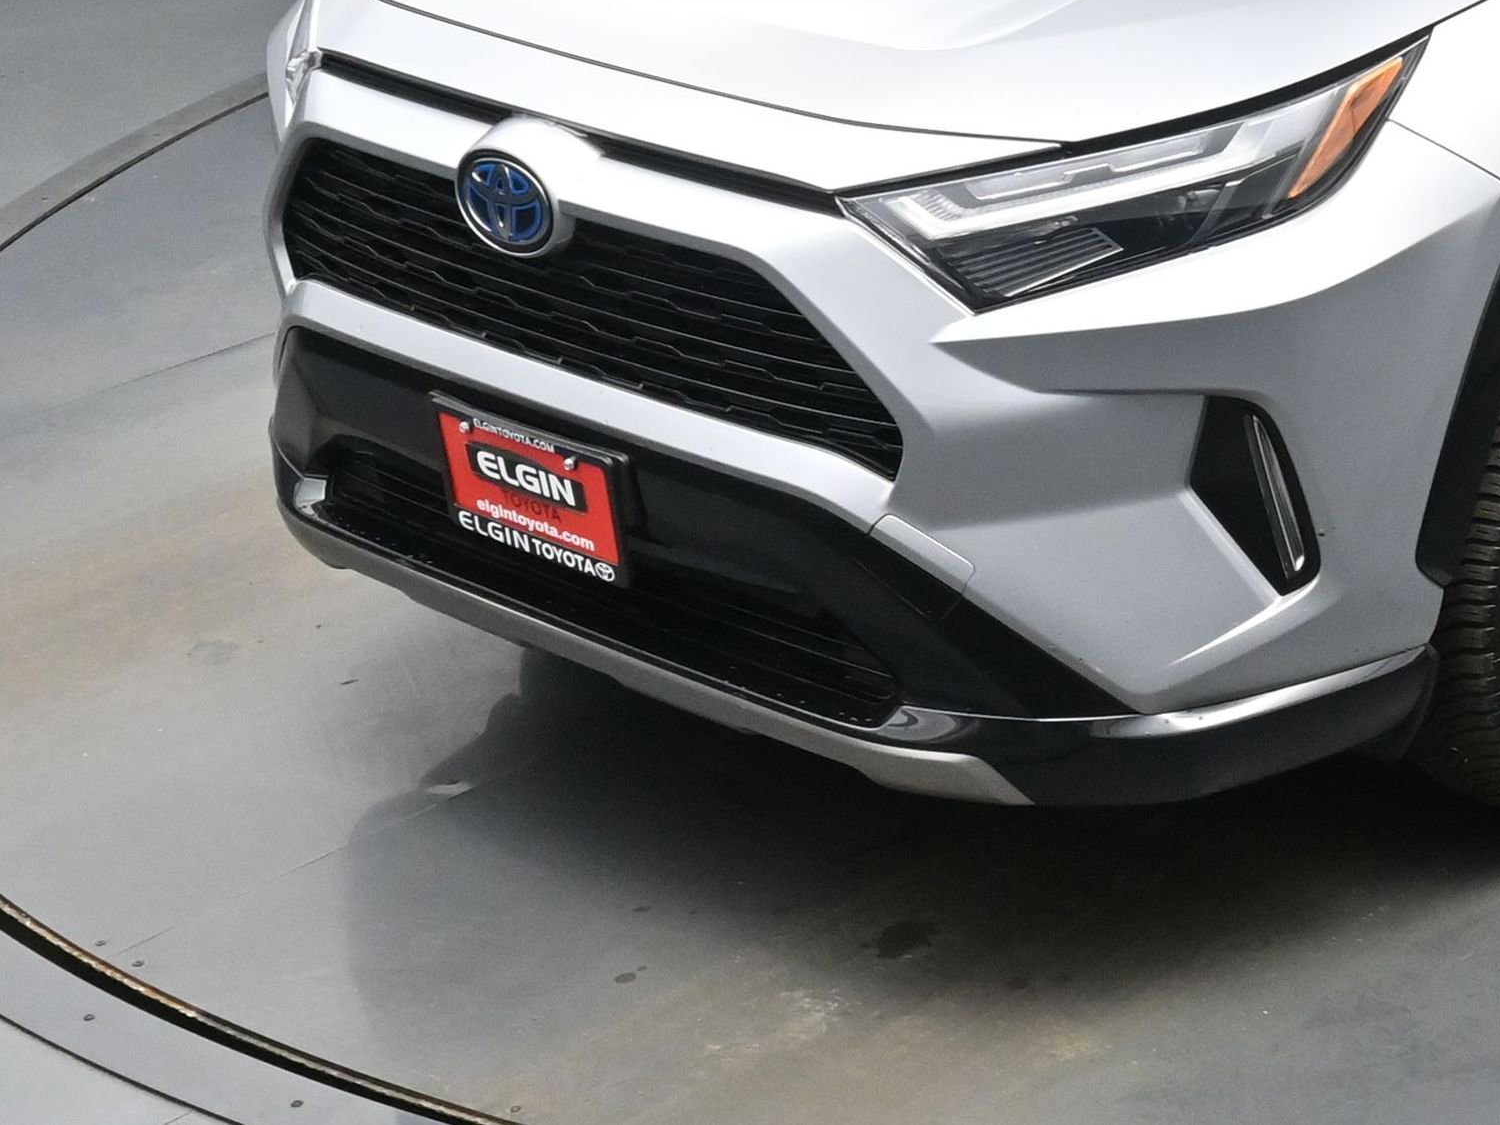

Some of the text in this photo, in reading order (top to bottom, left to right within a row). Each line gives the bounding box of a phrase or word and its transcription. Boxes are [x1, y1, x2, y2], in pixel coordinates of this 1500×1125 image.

[473, 417, 555, 453] ELGINTOYOTA.COM
[476, 451, 576, 507] ELGIN
[477, 498, 595, 552] elgintoyota.com
[503, 490, 561, 523] TOYOTA
[458, 510, 597, 577] ELGIN TOYOTA
